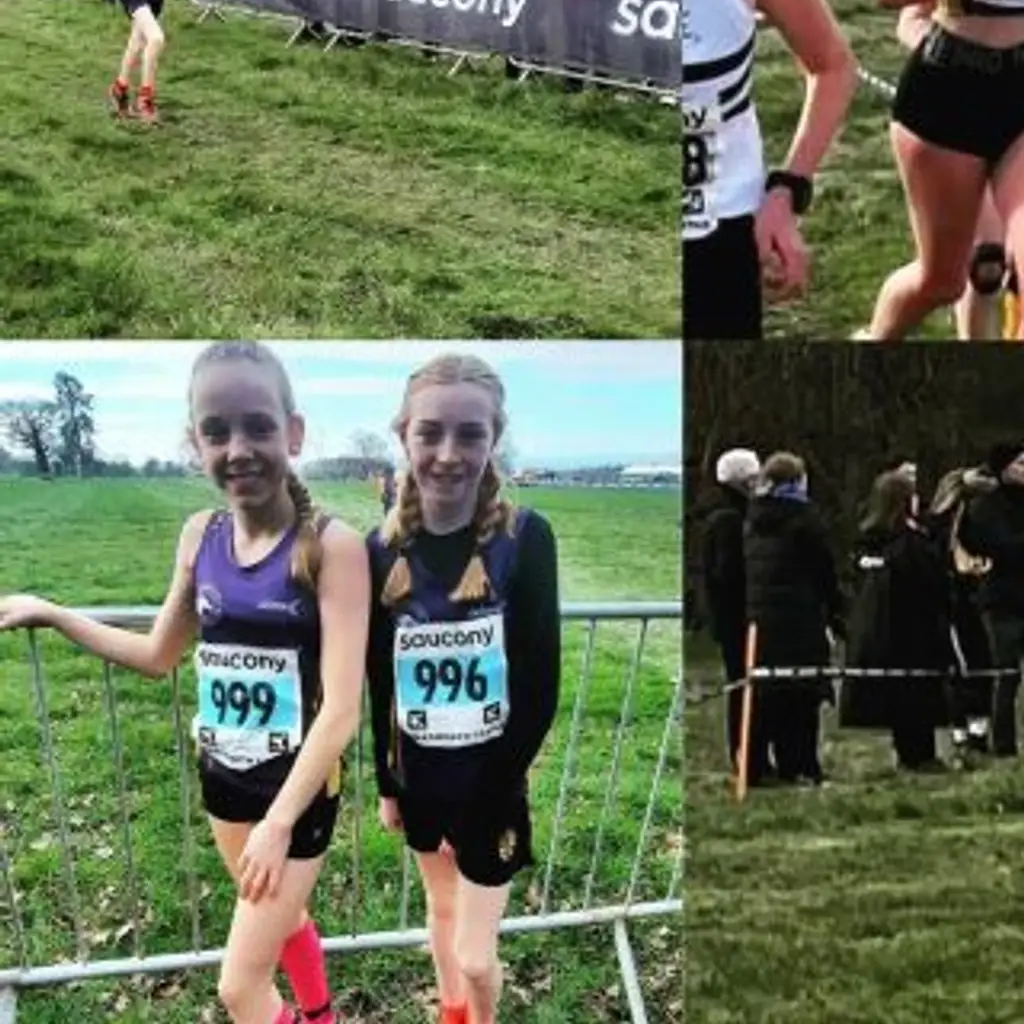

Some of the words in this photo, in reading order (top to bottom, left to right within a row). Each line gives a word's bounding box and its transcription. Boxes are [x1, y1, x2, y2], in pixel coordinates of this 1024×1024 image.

[400, 623, 495, 651] saucony
[210, 678, 278, 727] 999
[413, 657, 488, 705] 996
